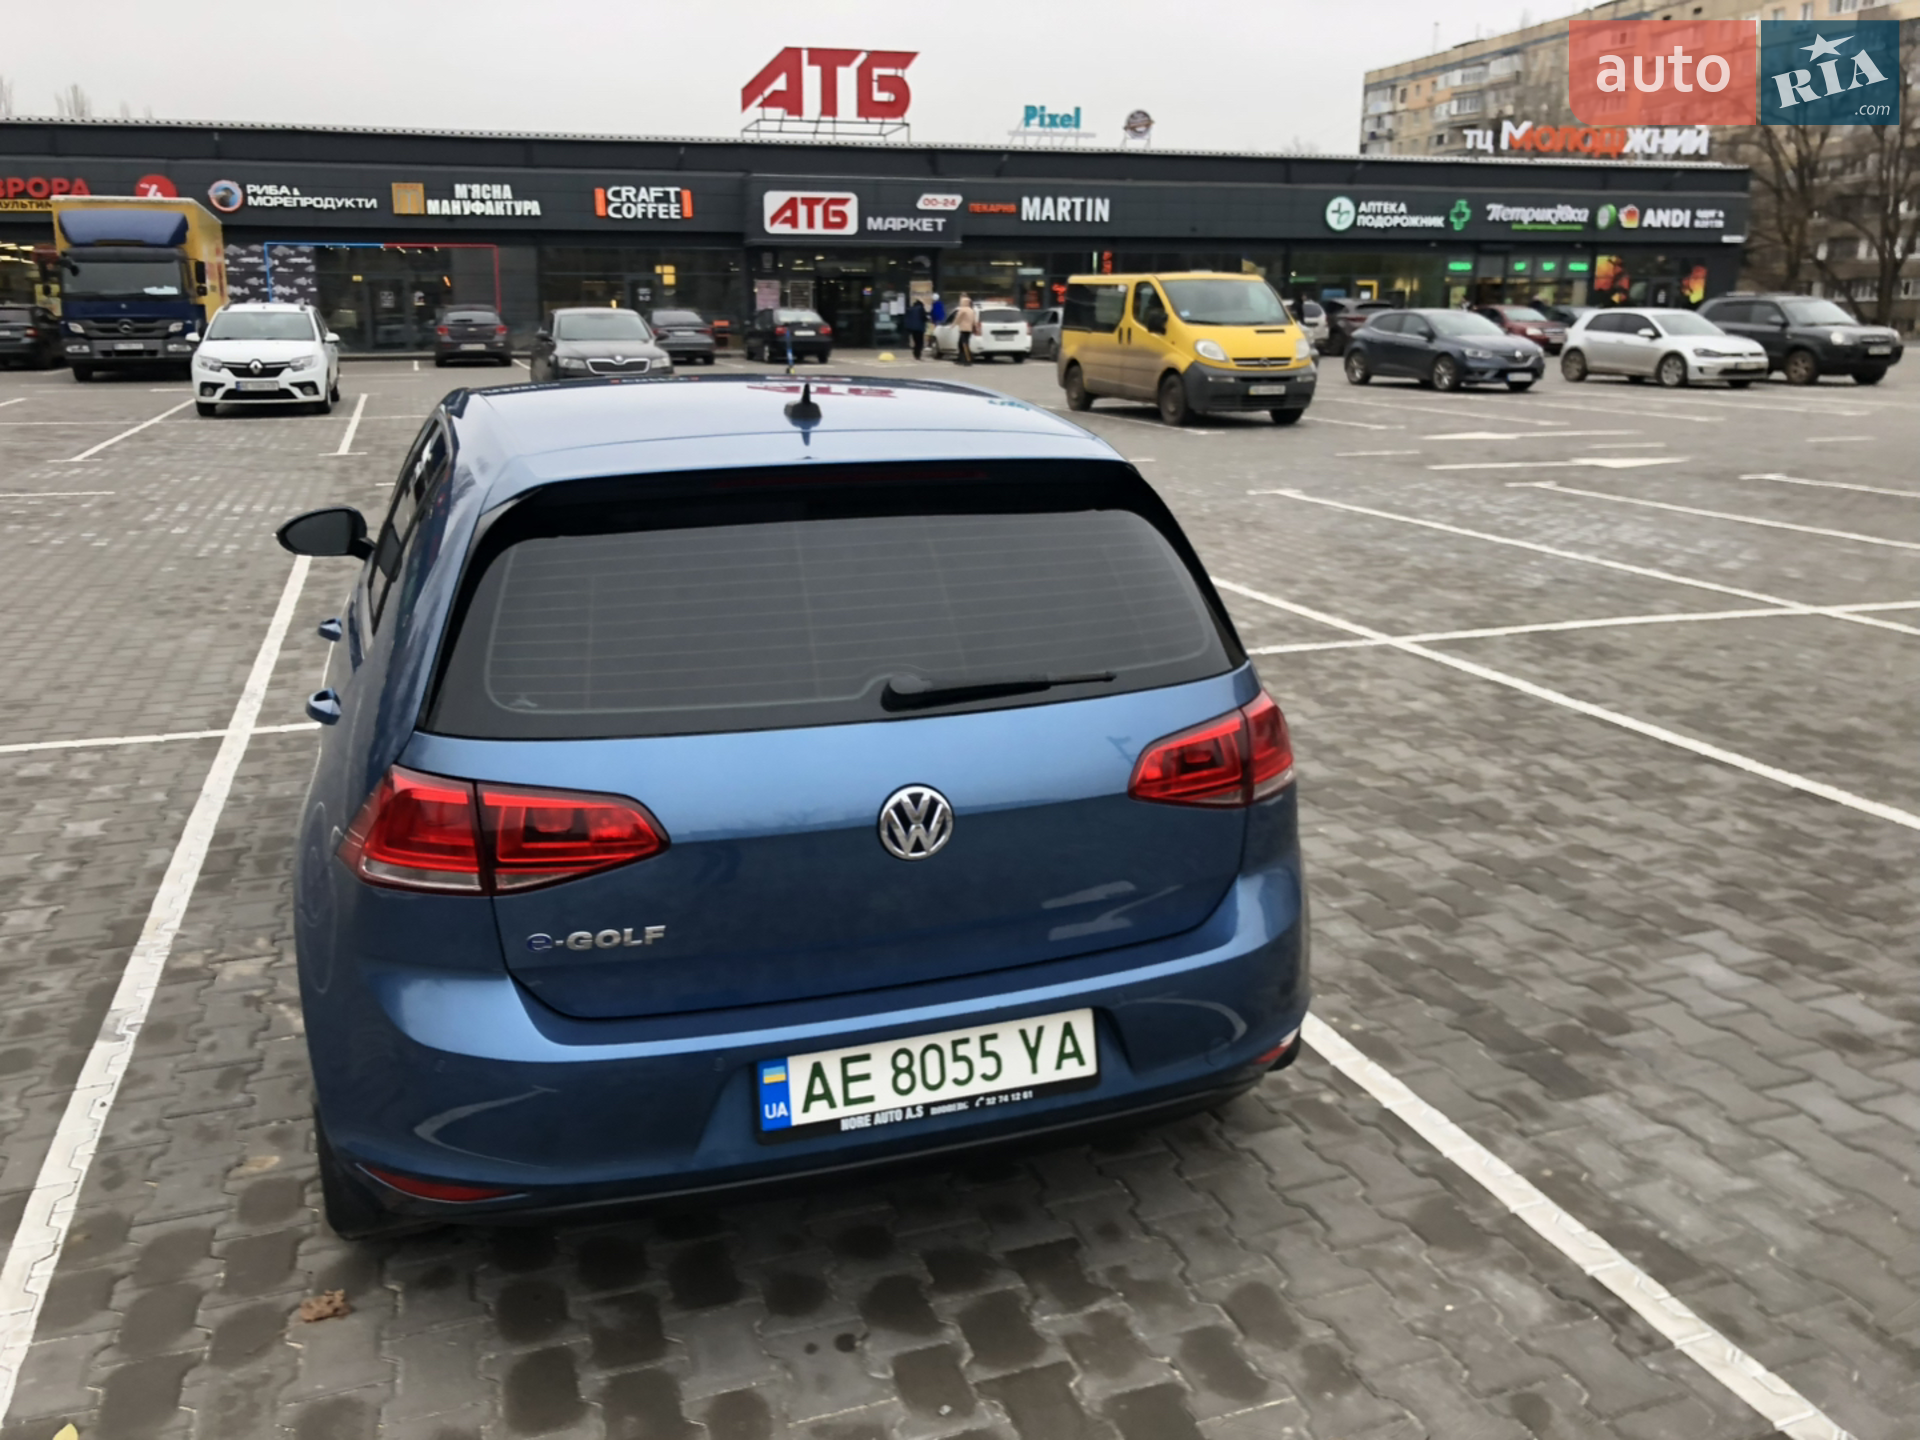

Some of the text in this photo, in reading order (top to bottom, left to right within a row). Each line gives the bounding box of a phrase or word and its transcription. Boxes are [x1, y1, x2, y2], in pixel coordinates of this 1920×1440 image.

[741, 46, 919, 119] АТБ
[1023, 105, 1081, 129] Pixel
[246, 184, 290, 196] РИБА
[607, 186, 681, 203] CRAFT
[247, 197, 377, 209] МОРЕПРОДУКТИ
[427, 199, 541, 215] МАНУФАКТУРА
[607, 203, 682, 219] COFFEE
[922, 197, 957, 208] 00-24
[1021, 196, 1110, 222] MARTIN
[1358, 201, 1407, 214] АПТЕКА
[770, 196, 851, 229] АТБ
[1642, 208, 1691, 228] ANDI
[867, 216, 946, 231] МАРКЕТ
[1356, 215, 1445, 228] ПОДОРОЖНИК
[526, 925, 667, 952] e-GOLF
[801, 1020, 1087, 1114] AE 8055 YA
[764, 1102, 789, 1120] UA
[873, 1107, 904, 1126] AUTO
